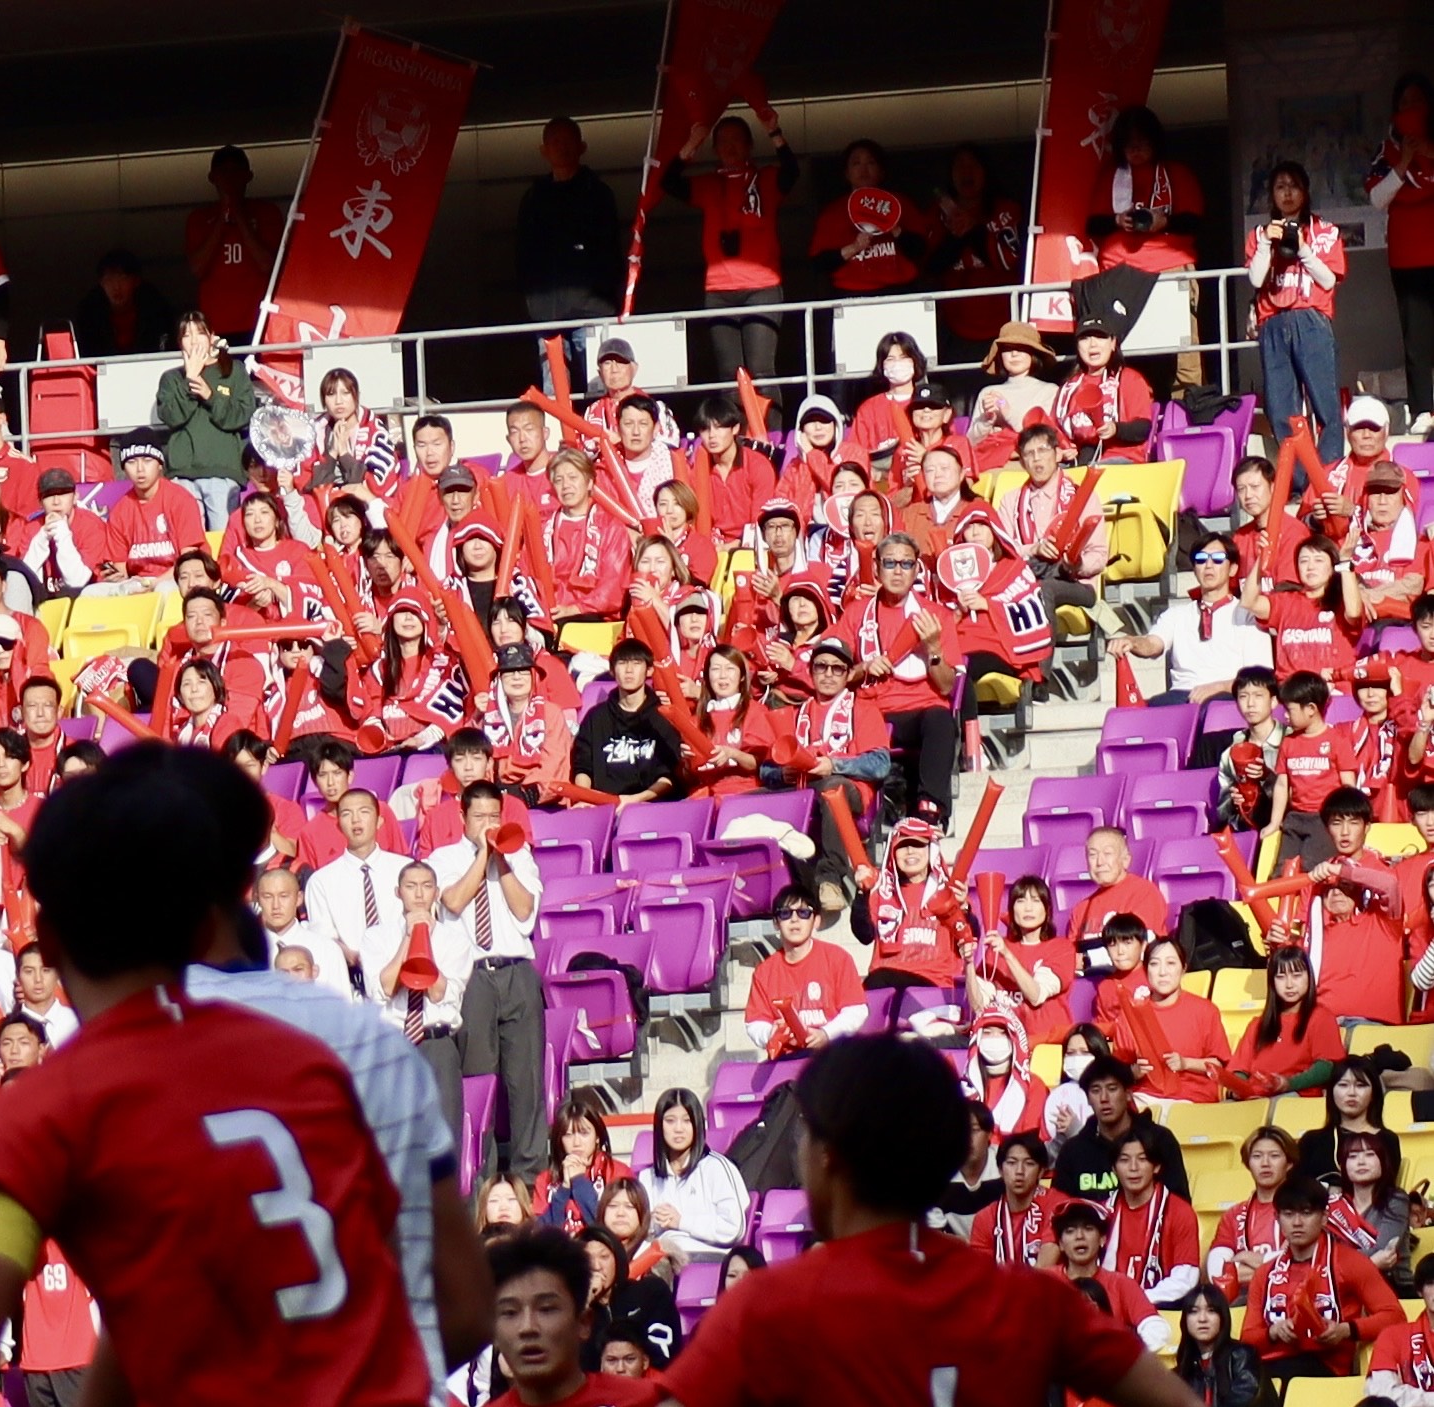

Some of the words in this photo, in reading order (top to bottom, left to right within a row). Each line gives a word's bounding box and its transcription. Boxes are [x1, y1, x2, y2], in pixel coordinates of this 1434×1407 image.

[357, 47, 462, 90] HIGASHIYAMA
[223, 243, 243, 264] 30
[202, 1110, 348, 1319] 3
[43, 1263, 67, 1291] 69
